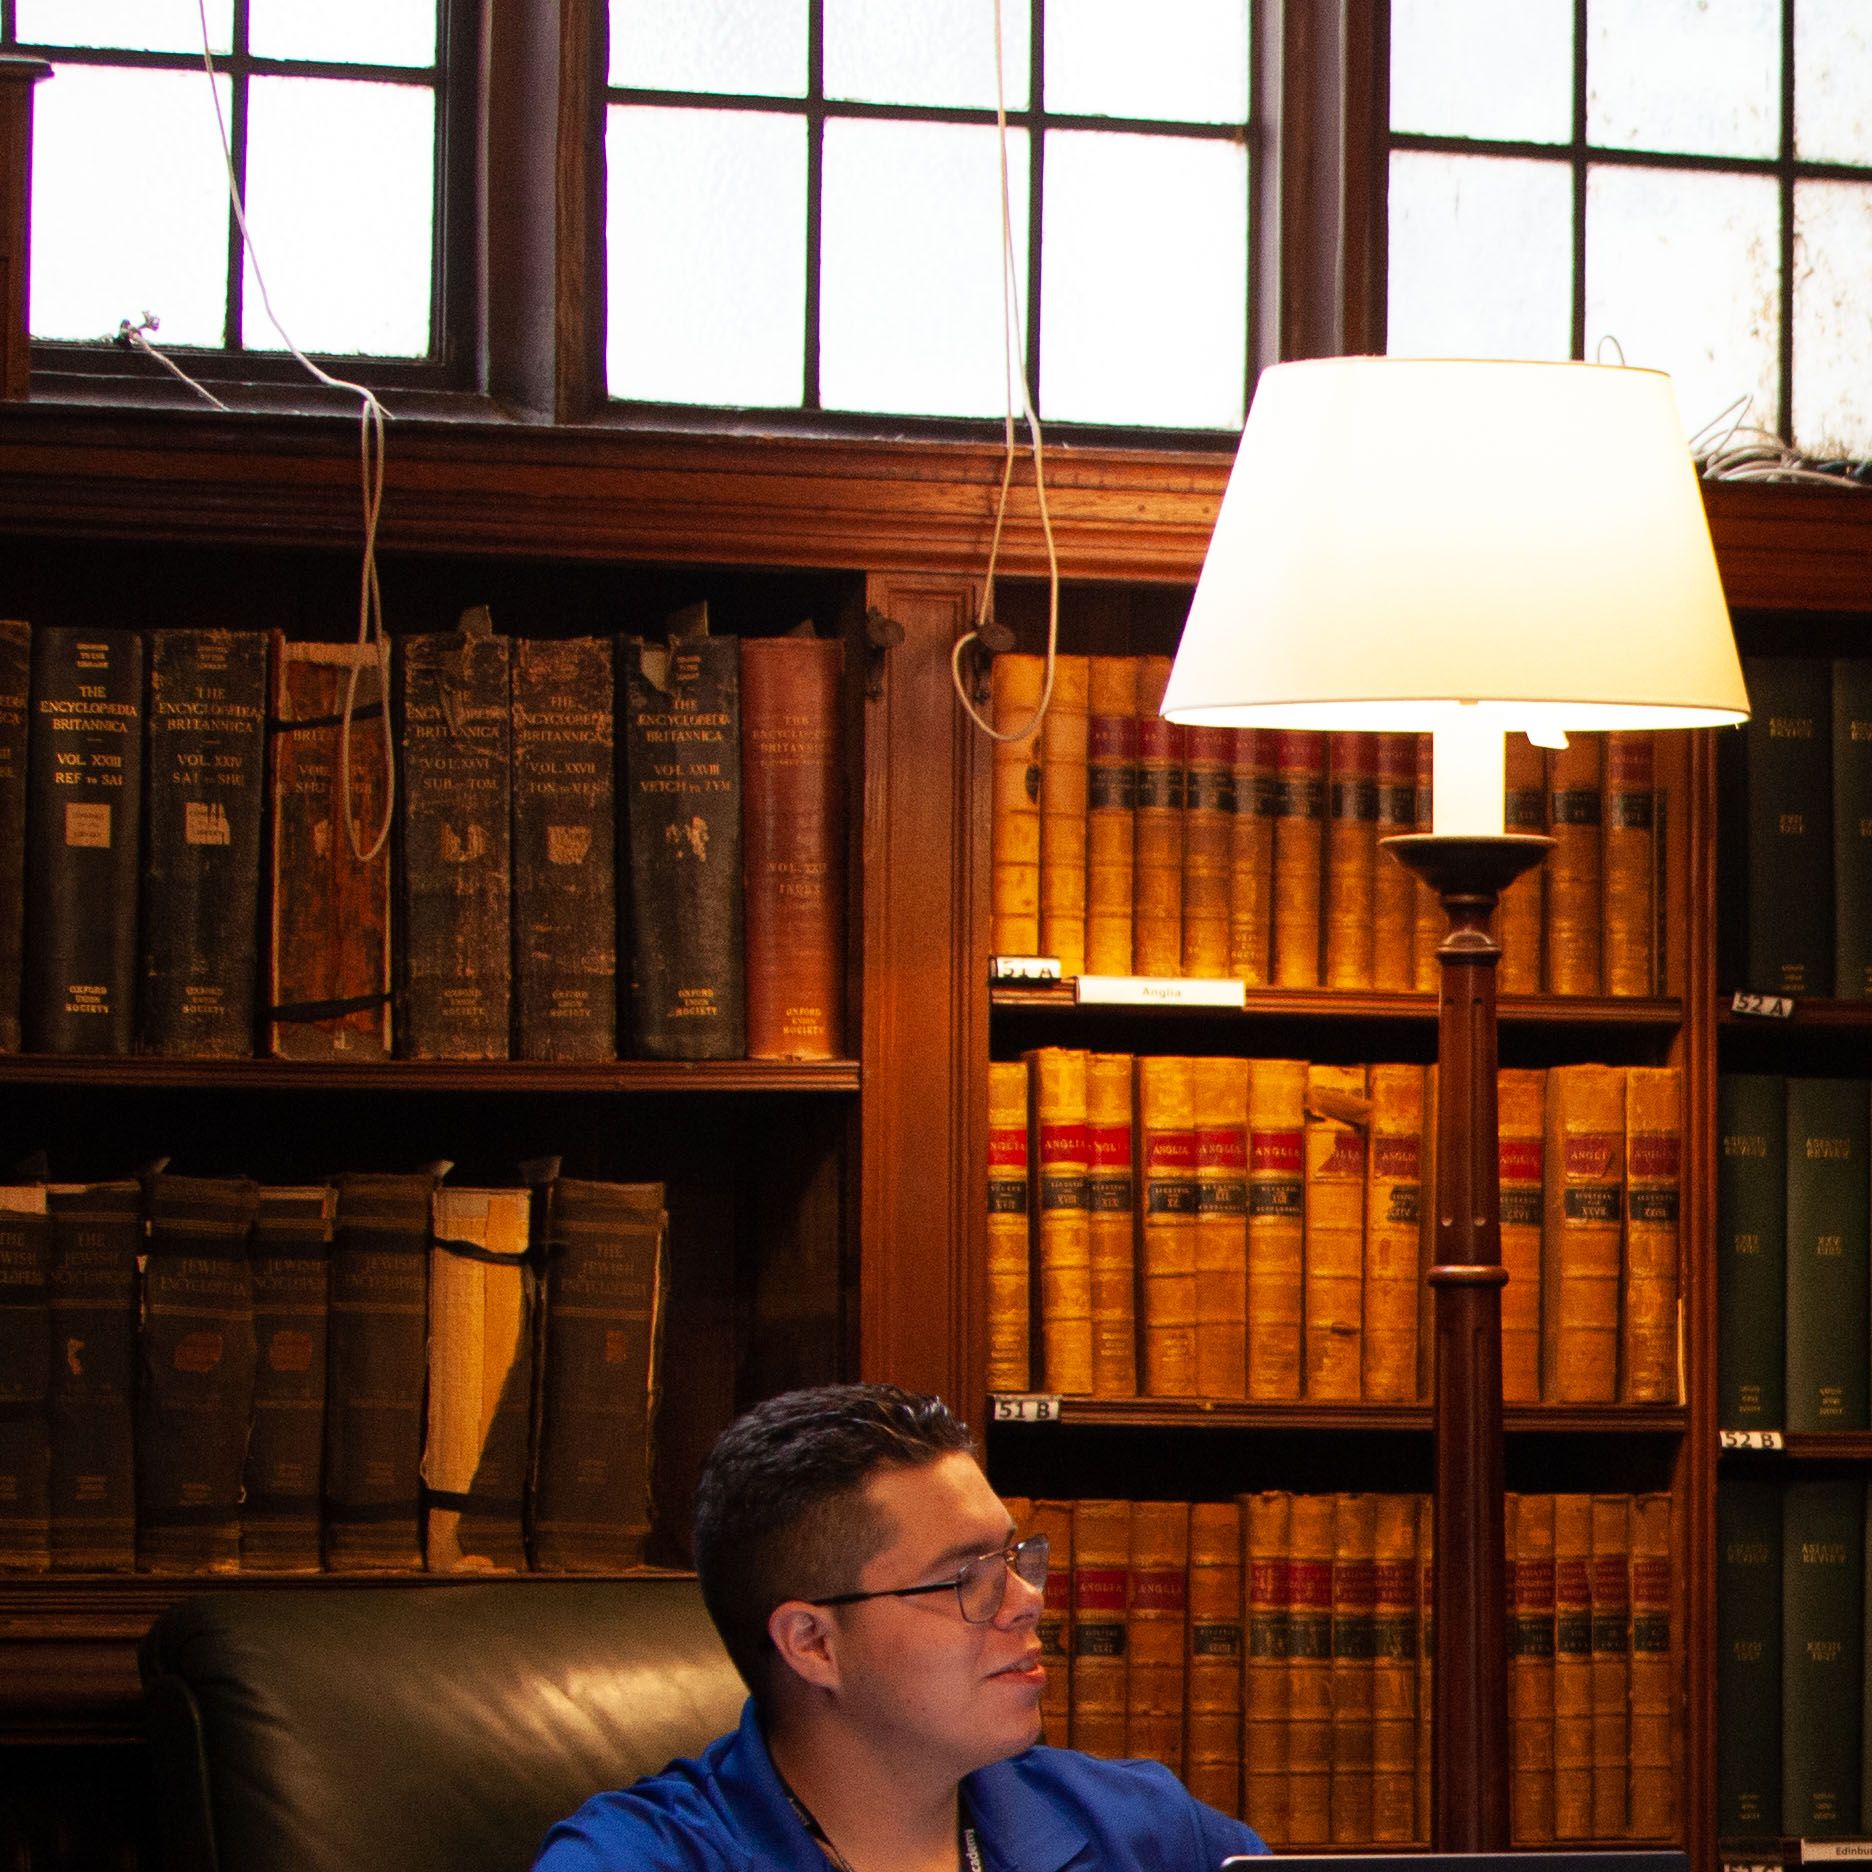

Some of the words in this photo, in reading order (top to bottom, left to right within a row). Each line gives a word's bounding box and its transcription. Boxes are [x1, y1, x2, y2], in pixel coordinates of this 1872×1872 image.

[79, 685, 107, 699] THE
[195, 687, 226, 699] THE
[52, 717, 128, 734] BRITANNICA
[168, 719, 254, 734] BRITANNICA
[644, 729, 723, 744] BRITANNICA
[55, 770, 82, 785] REF
[1140, 986, 1182, 999] Anglia
[1735, 993, 1759, 1011] 52
[1771, 1000, 1783, 1017] A
[1045, 1137, 1088, 1151] ANGLIA
[1153, 1144, 1190, 1156] ANGLIA
[1255, 1145, 1299, 1158] ANGLIA
[1000, 1400, 1026, 1418] 51
[1040, 1401, 1051, 1419] B
[1725, 1433, 1751, 1449] 52
[1762, 1435, 1774, 1449] B
[1803, 1553, 1848, 1564] REVIEW
[1079, 1582, 1123, 1594] ANGLIA
[1140, 1583, 1184, 1595] ANGLIA
